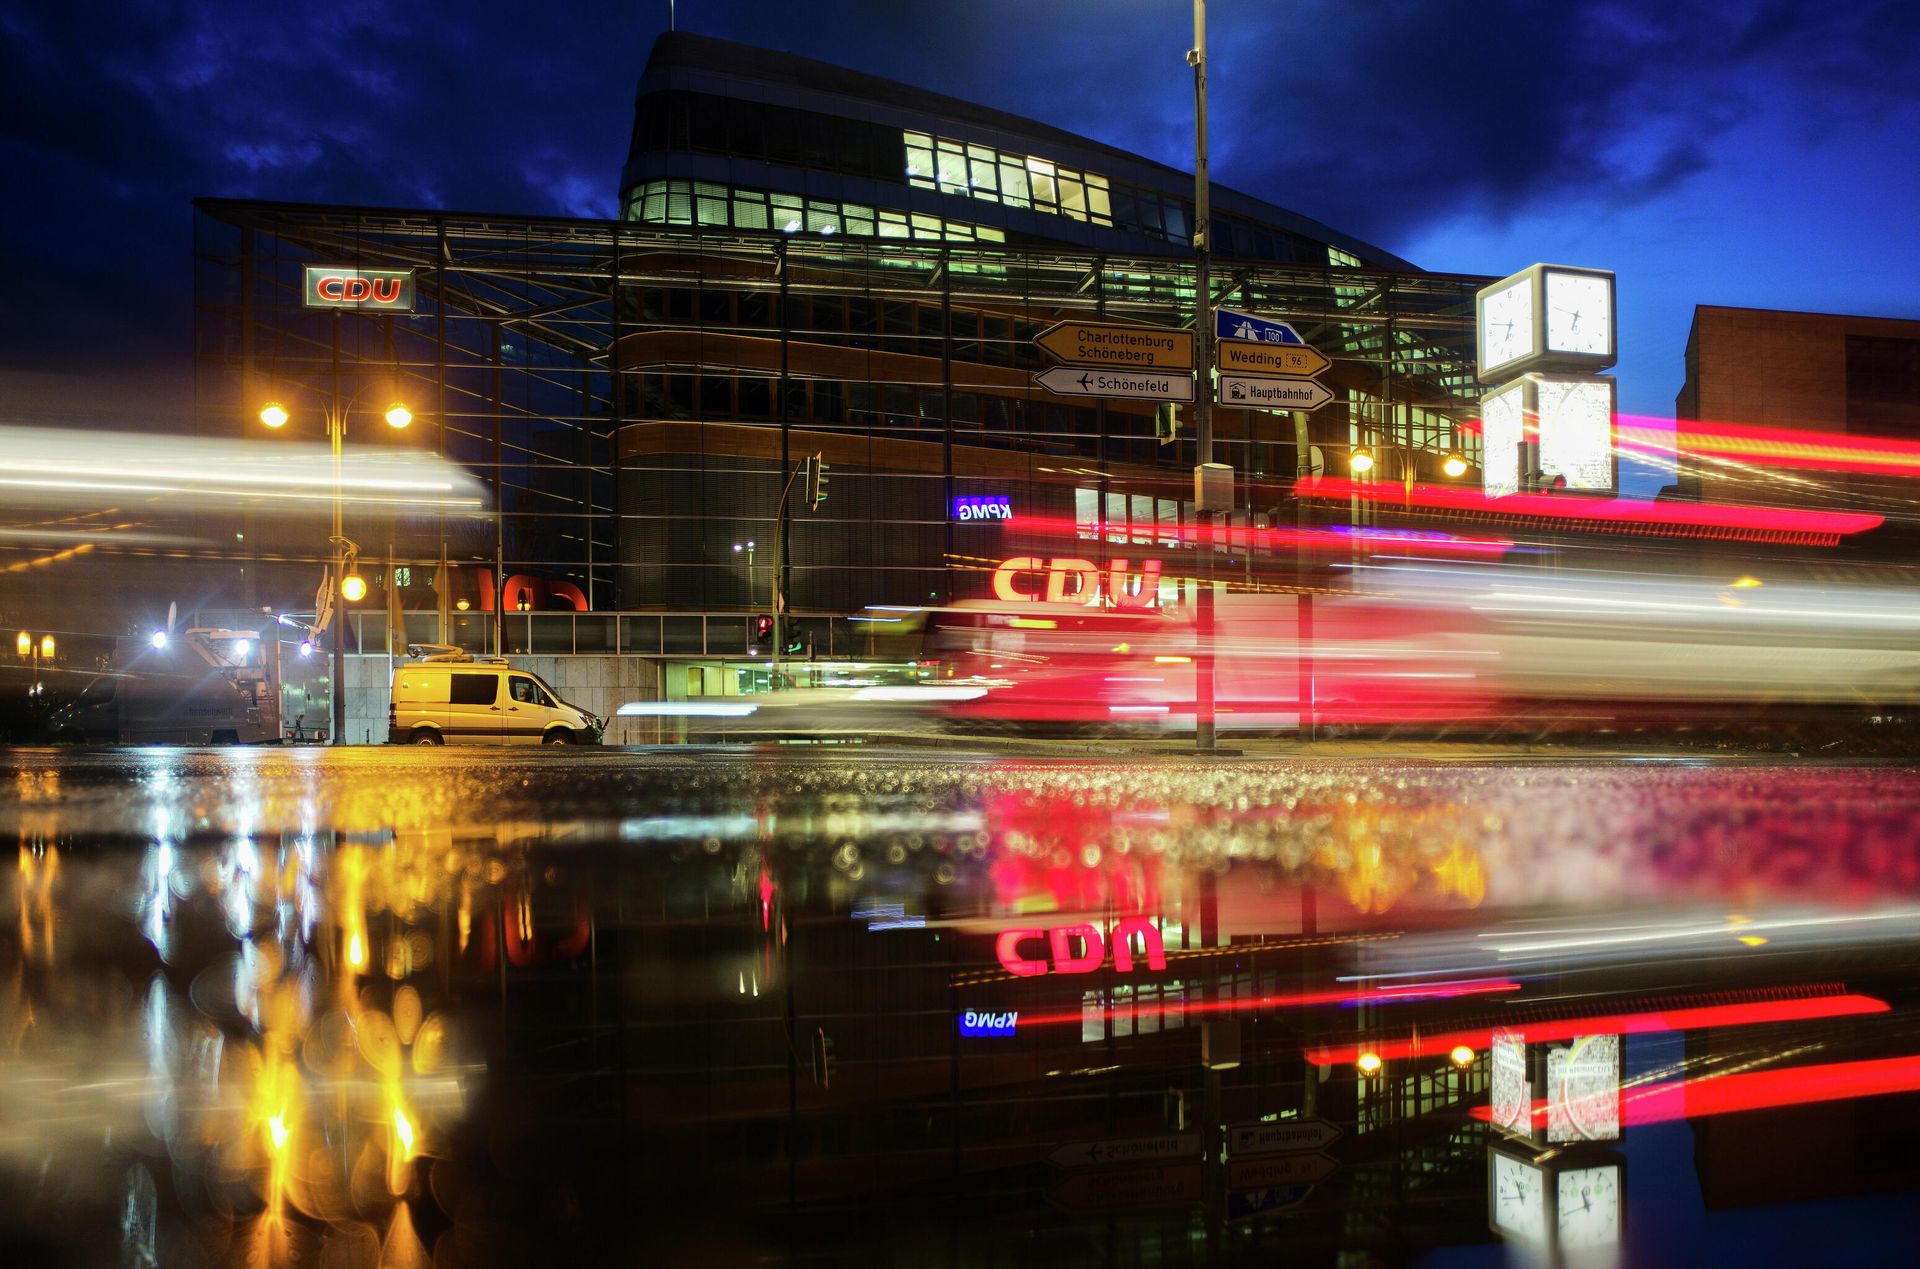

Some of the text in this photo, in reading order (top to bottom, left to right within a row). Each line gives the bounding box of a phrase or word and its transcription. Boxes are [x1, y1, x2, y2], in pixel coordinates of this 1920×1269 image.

[317, 276, 401, 304] CDU
[1078, 330, 1174, 351] Charlottenburg
[1268, 331, 1280, 342] 100
[1078, 345, 1154, 365] Schöneberg
[1230, 350, 1302, 369] Wedding 96
[1098, 376, 1169, 392] Schönefeld
[1250, 386, 1313, 401] Hauptbahnhof
[992, 556, 1162, 607] CDU
[964, 1011, 1018, 1029] KPMG
